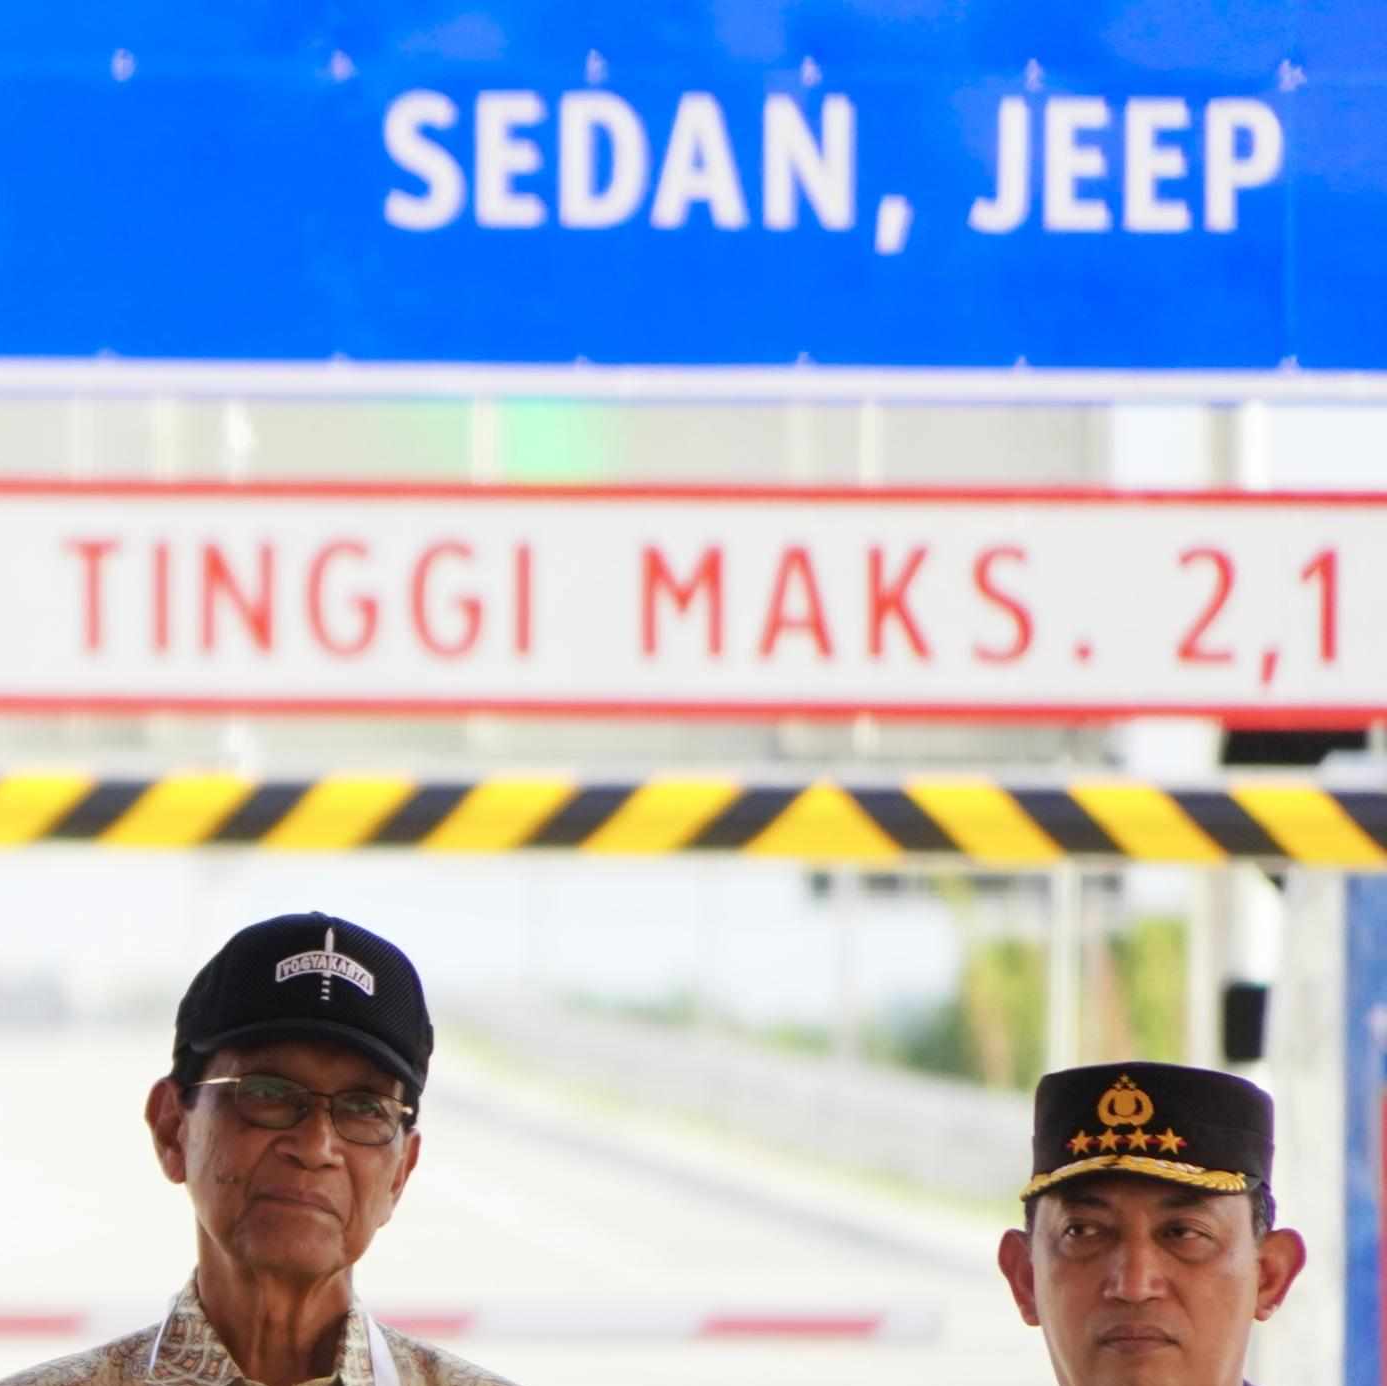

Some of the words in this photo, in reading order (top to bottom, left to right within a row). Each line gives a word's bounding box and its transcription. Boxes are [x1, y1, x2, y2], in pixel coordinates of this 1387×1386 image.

[384, 91, 911, 254] SEDAN,
[969, 96, 1284, 233] JEEP
[68, 538, 534, 659] TINGGI
[639, 543, 1094, 666] MAKS.
[1173, 546, 1341, 686] 2,1
[281, 953, 372, 991] YOGYAKARTA
